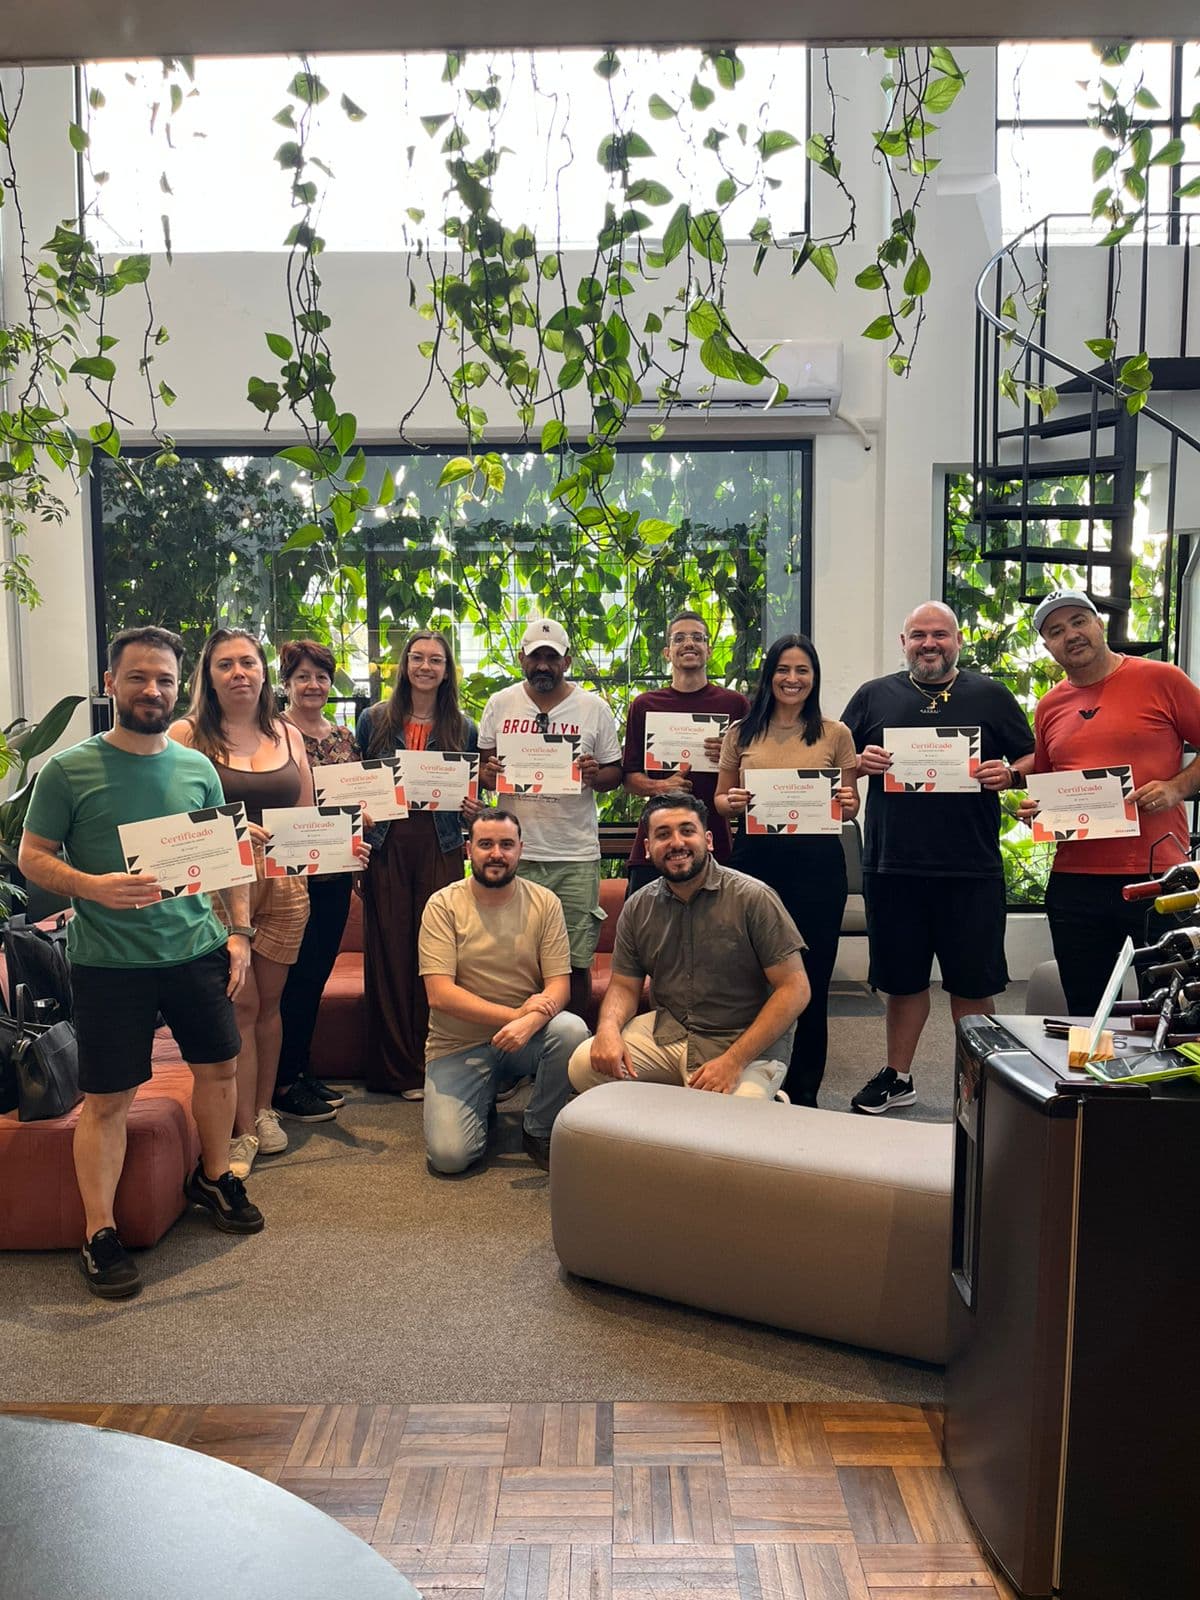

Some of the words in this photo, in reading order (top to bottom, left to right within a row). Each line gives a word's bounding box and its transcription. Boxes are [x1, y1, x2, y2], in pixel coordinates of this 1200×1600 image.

[503, 719, 579, 734] BROOLYN
[420, 764, 456, 772] Certificado
[340, 775, 378, 783] Certificado
[1057, 785, 1103, 794] Certificado
[292, 821, 335, 830] Certificado
[160, 828, 214, 845] Certificado
